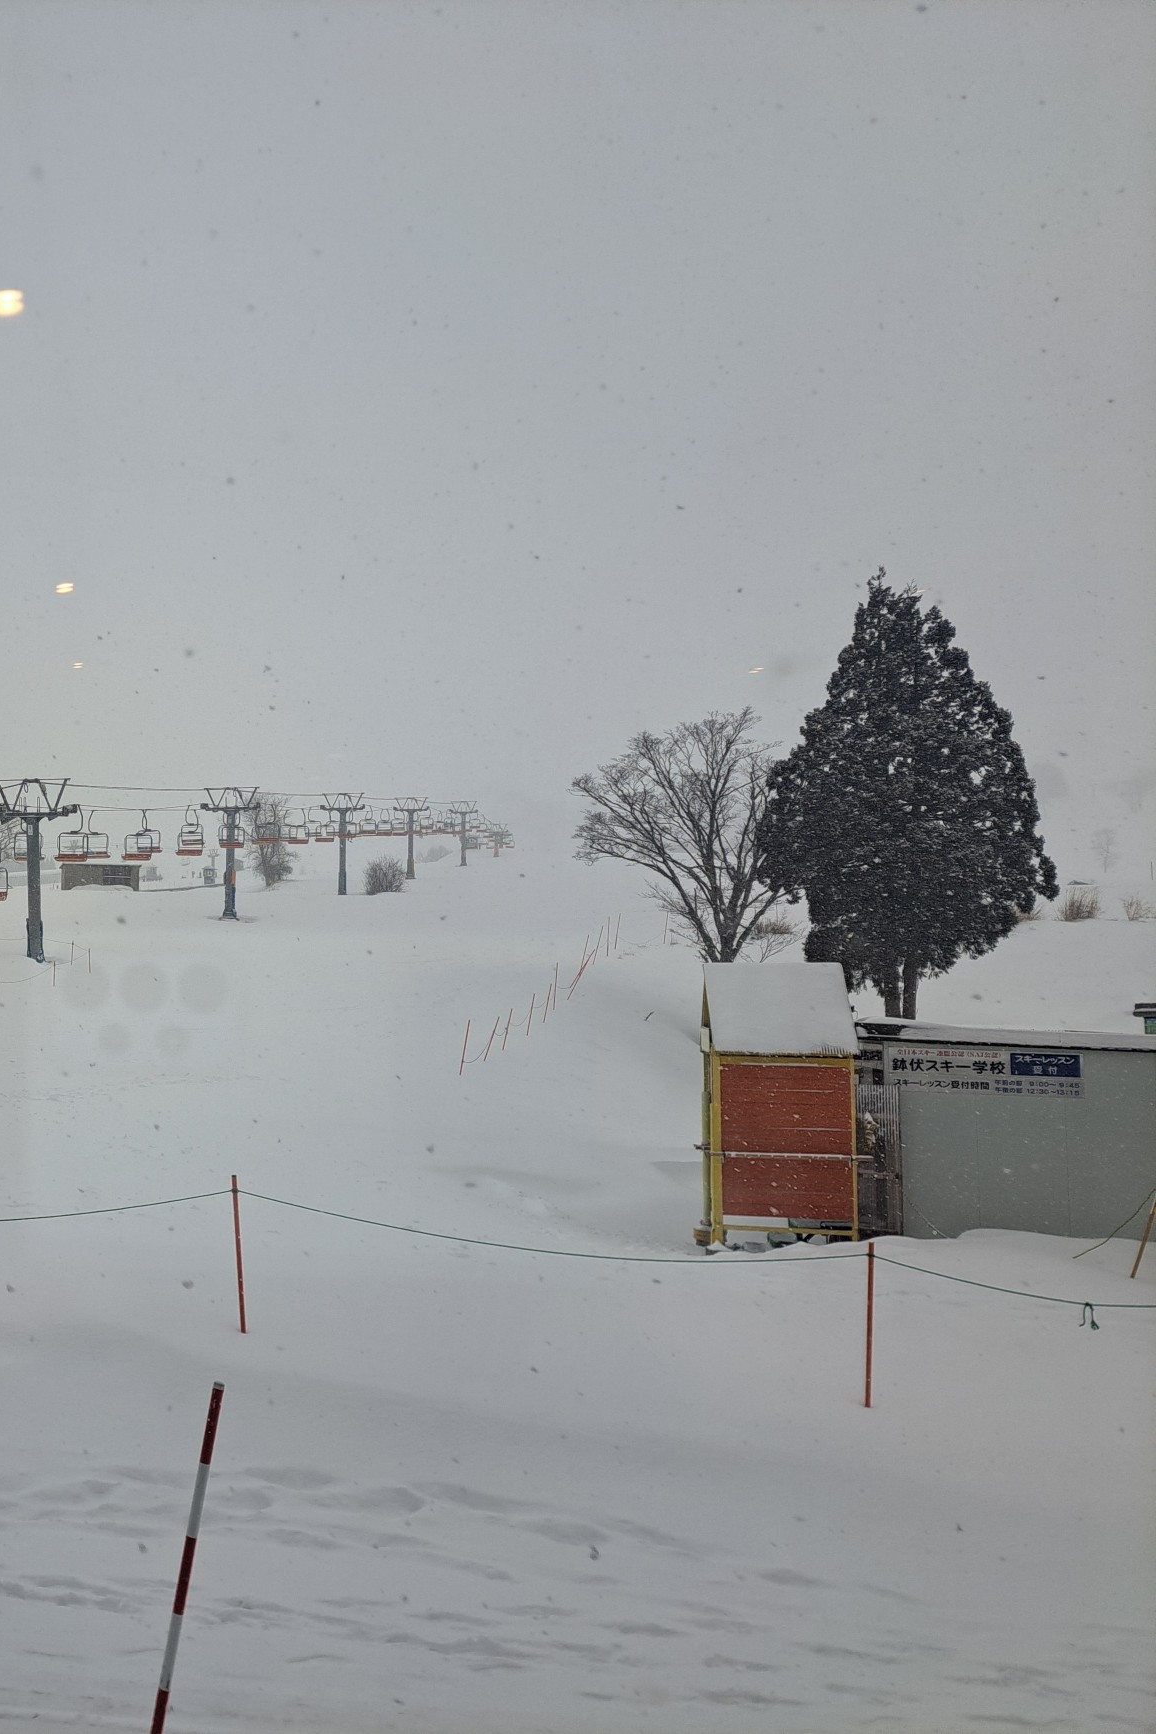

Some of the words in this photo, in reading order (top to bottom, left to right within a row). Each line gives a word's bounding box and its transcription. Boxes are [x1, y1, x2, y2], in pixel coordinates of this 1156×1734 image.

[1014, 1054, 1075, 1065] スキーレッスン
[892, 1058, 1006, 1075] 鉢伏スキー学校
[1032, 1065, 1058, 1075] 受付
[894, 1079, 990, 1091] スキーレッスン受付時間
